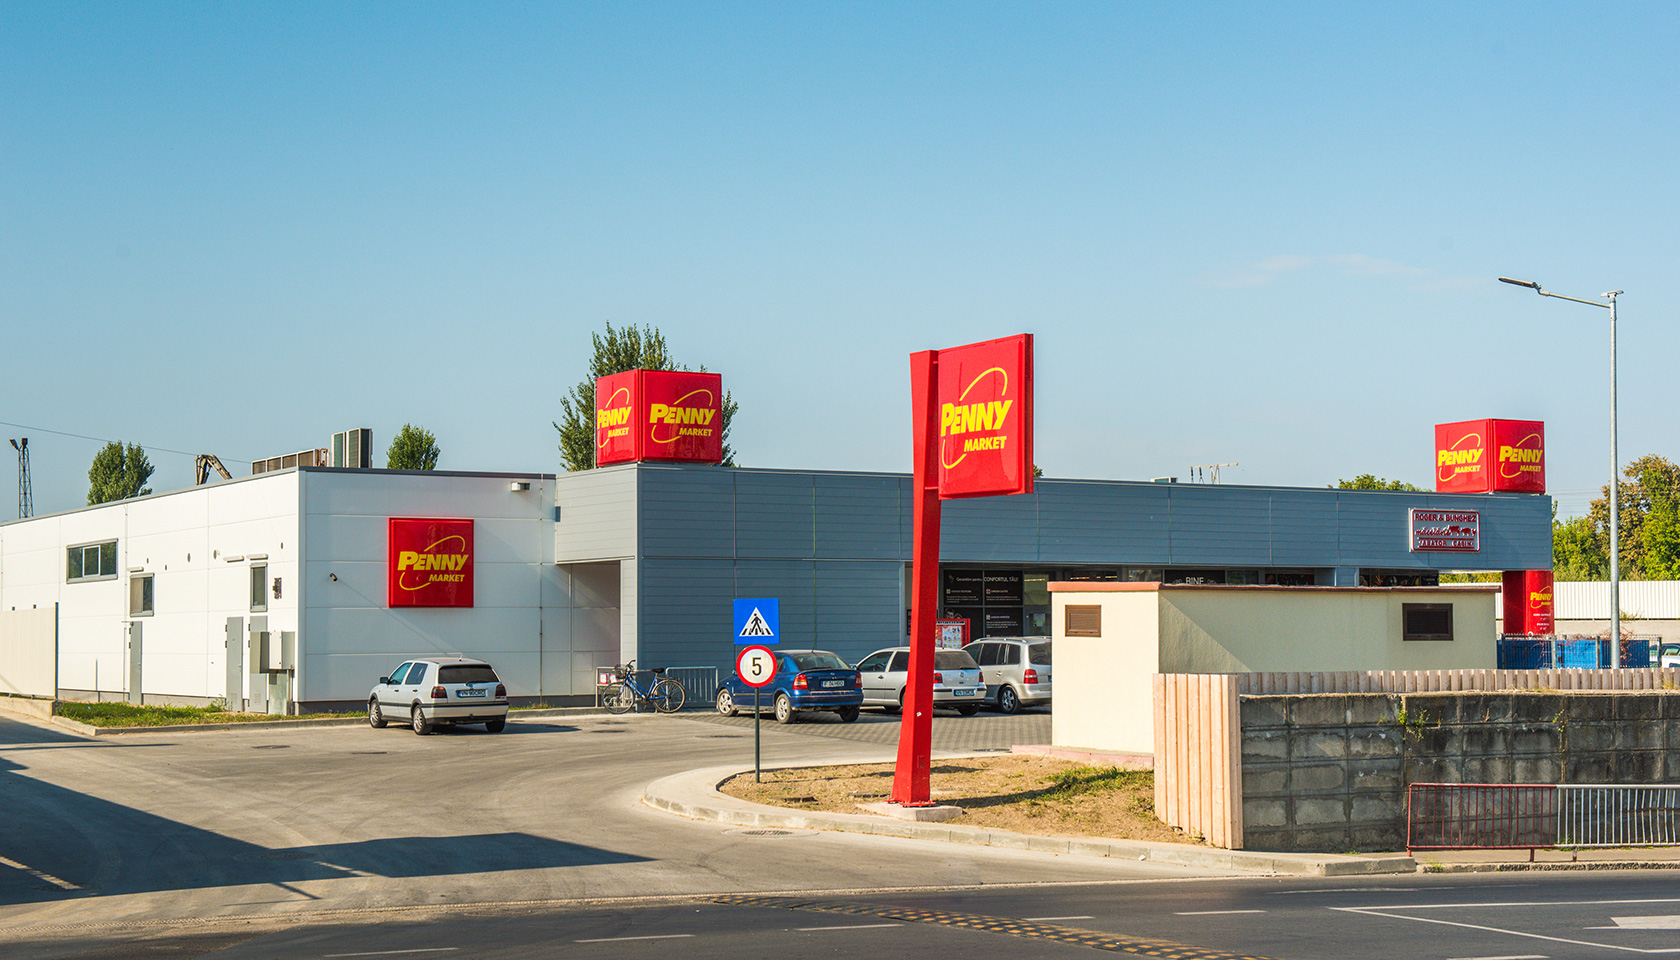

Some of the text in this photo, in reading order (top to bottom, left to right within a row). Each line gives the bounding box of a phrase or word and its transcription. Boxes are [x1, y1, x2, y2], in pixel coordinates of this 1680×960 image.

[598, 406, 632, 430] PENNY
[649, 403, 716, 425] PENNY
[941, 400, 1014, 437] PENNY
[608, 427, 630, 438] MARKET
[679, 427, 713, 437] MARKET
[963, 436, 1007, 452] MARKET
[1437, 448, 1484, 467] PENNY
[1499, 446, 1543, 463] PENNY
[1454, 465, 1481, 474] MARKET
[1415, 513, 1477, 523] ROGER & BUNGHEZ
[397, 551, 469, 571] PENNY
[428, 574, 465, 582] MARKET
[1530, 592, 1553, 601] PENNY
[752, 657, 762, 676] 5
